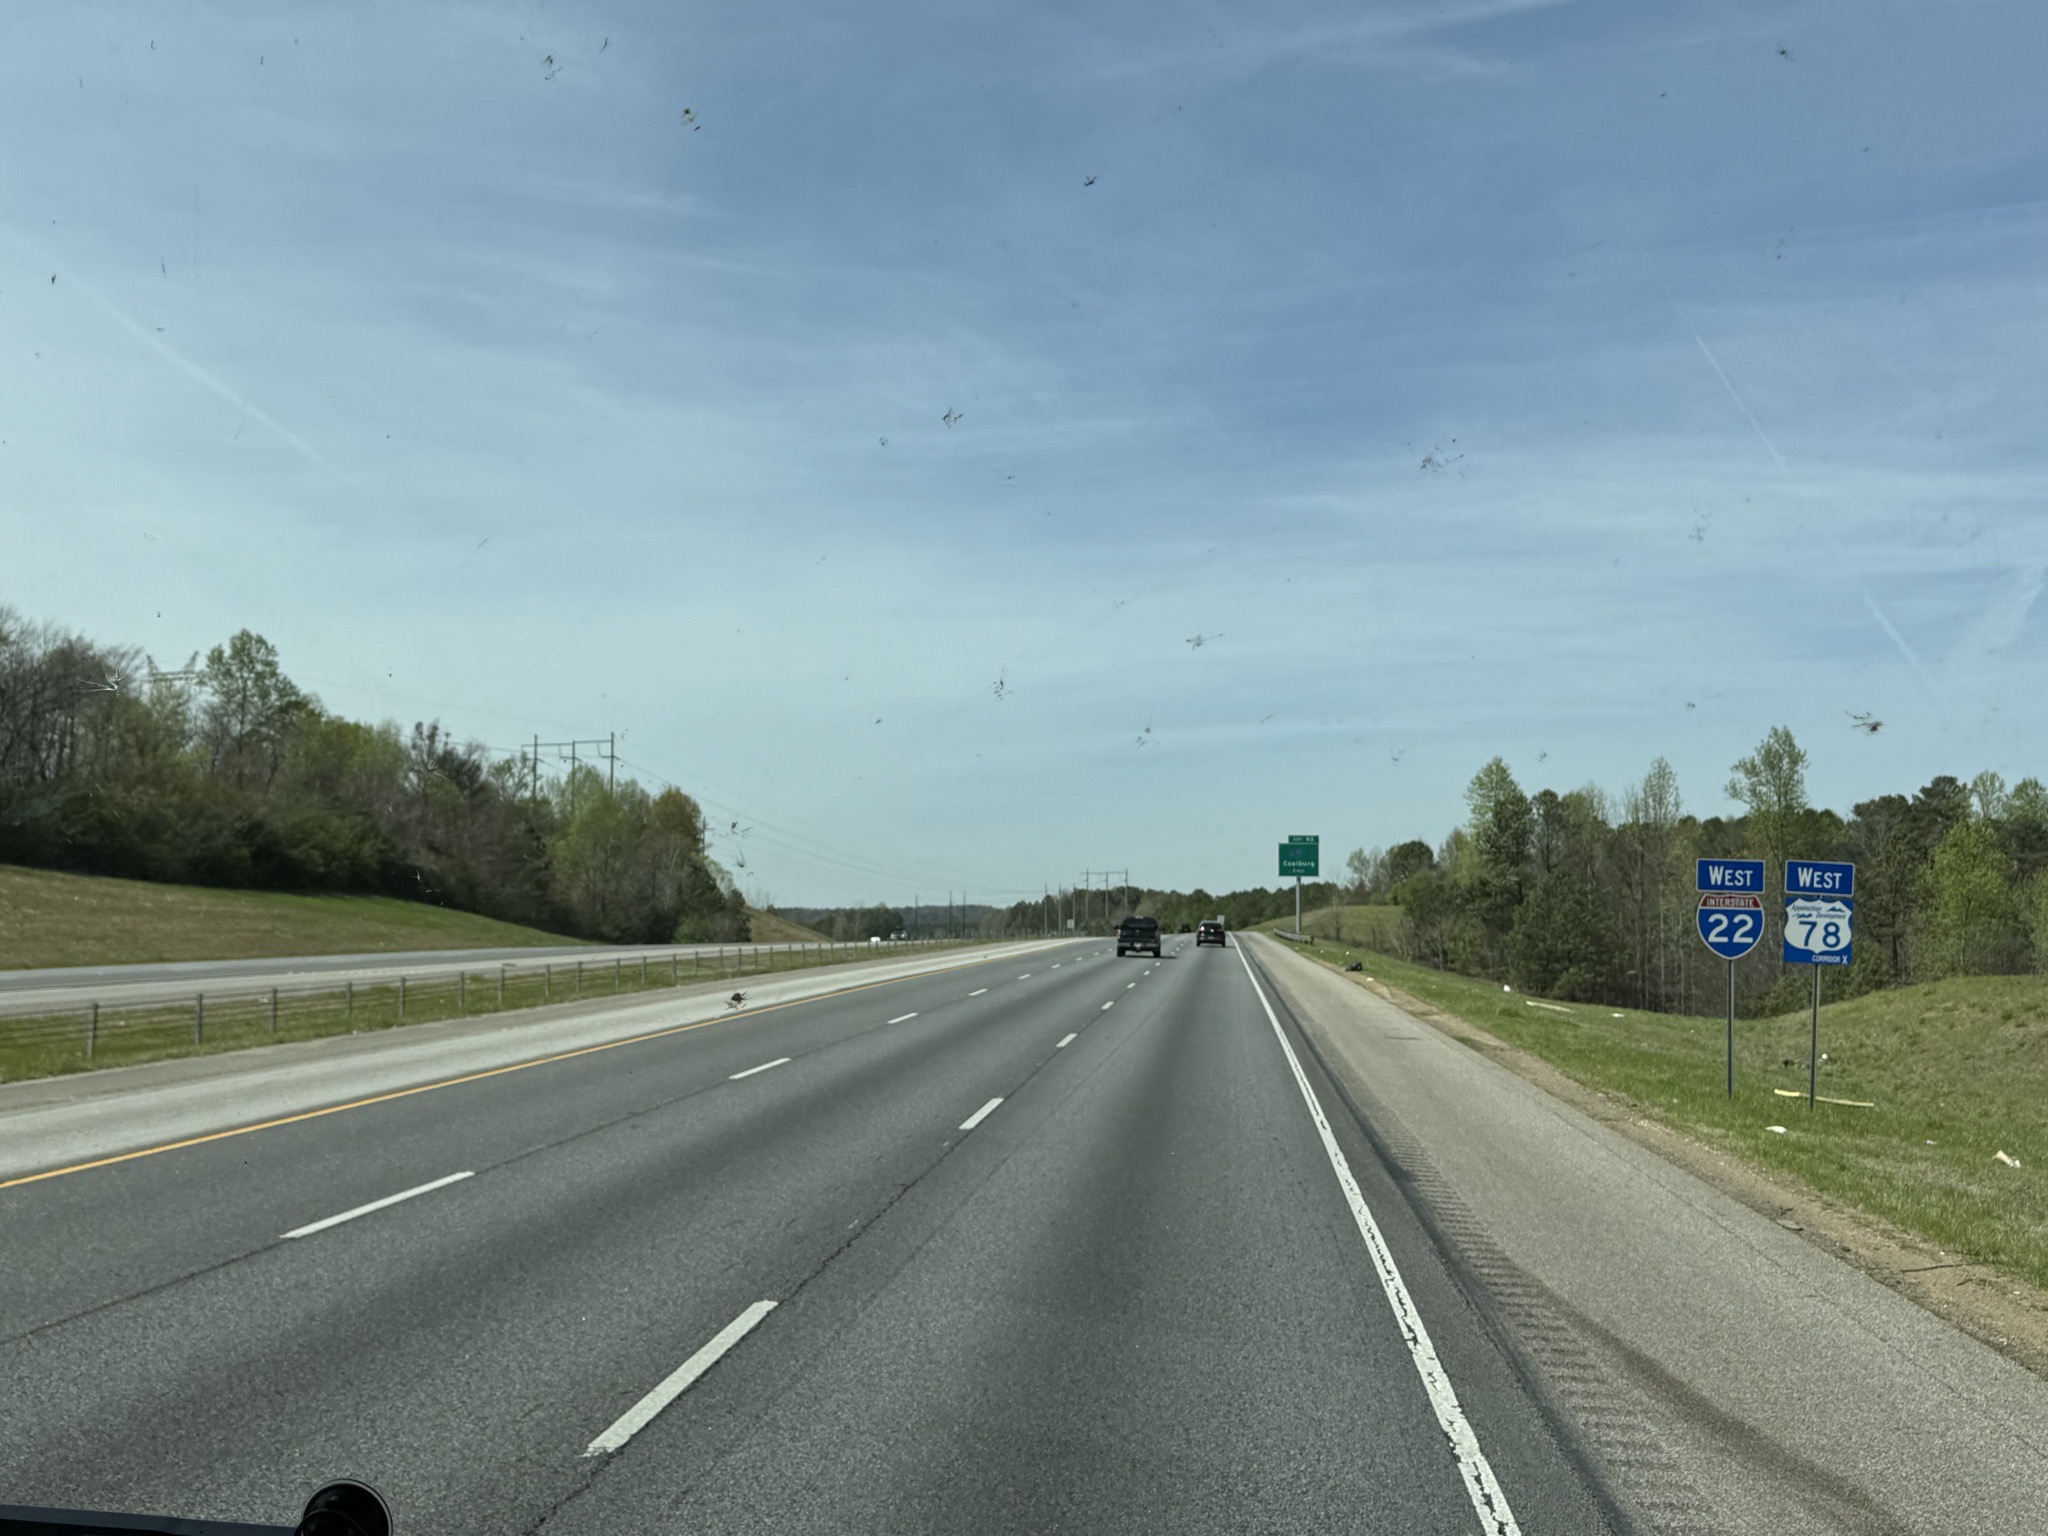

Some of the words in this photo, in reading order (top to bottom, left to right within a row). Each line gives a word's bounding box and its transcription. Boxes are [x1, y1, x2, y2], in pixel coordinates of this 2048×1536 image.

[1708, 865, 1753, 887] WEST
[1797, 867, 1843, 889] WEST
[1706, 898, 1755, 908] INTERSTATE
[1707, 913, 1754, 944] 22
[1799, 920, 1841, 949] 78
[1811, 954, 1841, 964] CORRIDOR
[1842, 954, 1848, 965] X
